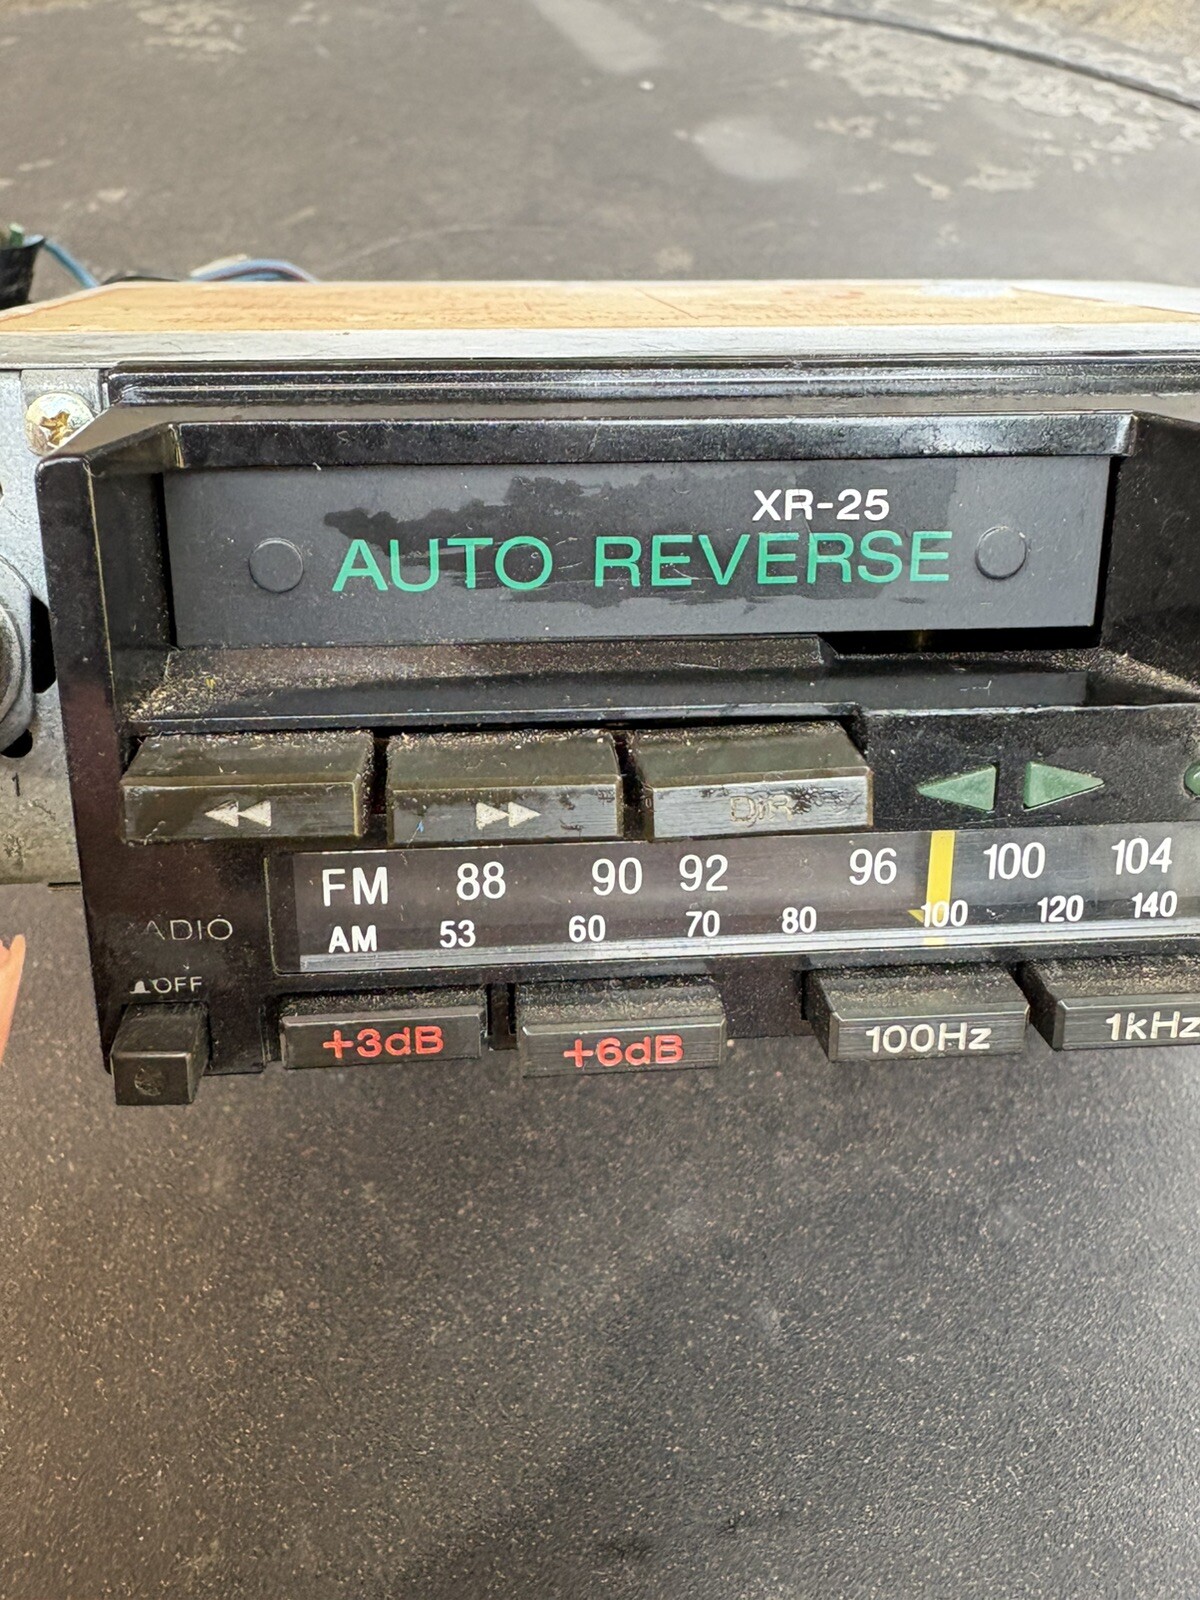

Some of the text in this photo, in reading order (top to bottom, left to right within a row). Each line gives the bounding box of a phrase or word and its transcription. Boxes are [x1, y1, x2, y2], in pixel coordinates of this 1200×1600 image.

[752, 489, 890, 522] XR-25
[332, 530, 953, 593] AUTO REVERSE
[322, 836, 1173, 907] FM 88 90 92 96 100 104
[141, 918, 233, 941] ADIO
[328, 890, 1178, 954] AM 53 60 70 80 100 120 140
[153, 976, 202, 993] OFF
[865, 1023, 993, 1054] 100Hz
[1106, 1011, 1200, 1041] 1kHz
[322, 1025, 445, 1060] +3dB
[564, 1034, 684, 1066] +6dB
